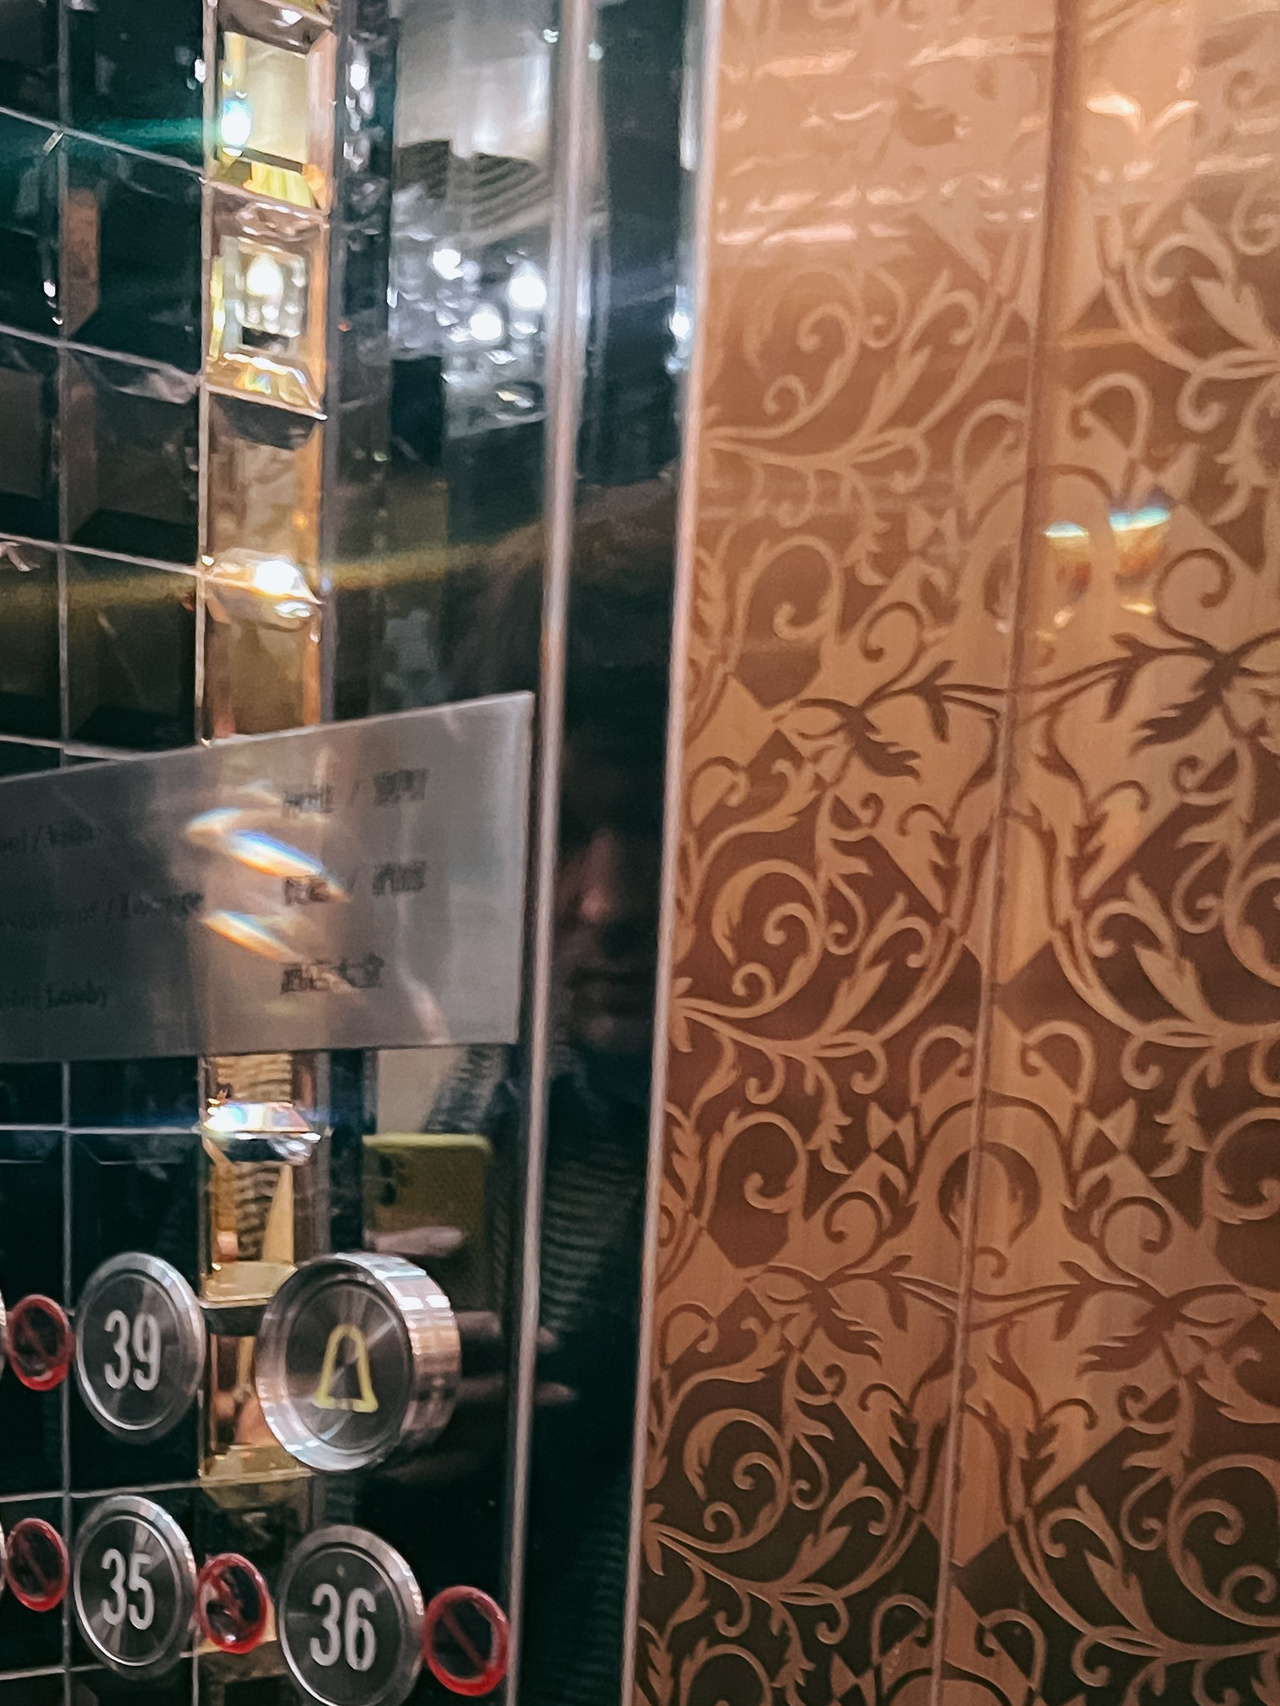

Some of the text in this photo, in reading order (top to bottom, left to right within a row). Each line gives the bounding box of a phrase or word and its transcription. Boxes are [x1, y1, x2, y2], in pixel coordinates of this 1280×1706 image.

[104, 1310, 161, 1391] 39
[101, 1549, 153, 1629] 35
[310, 1584, 375, 1670] 36
